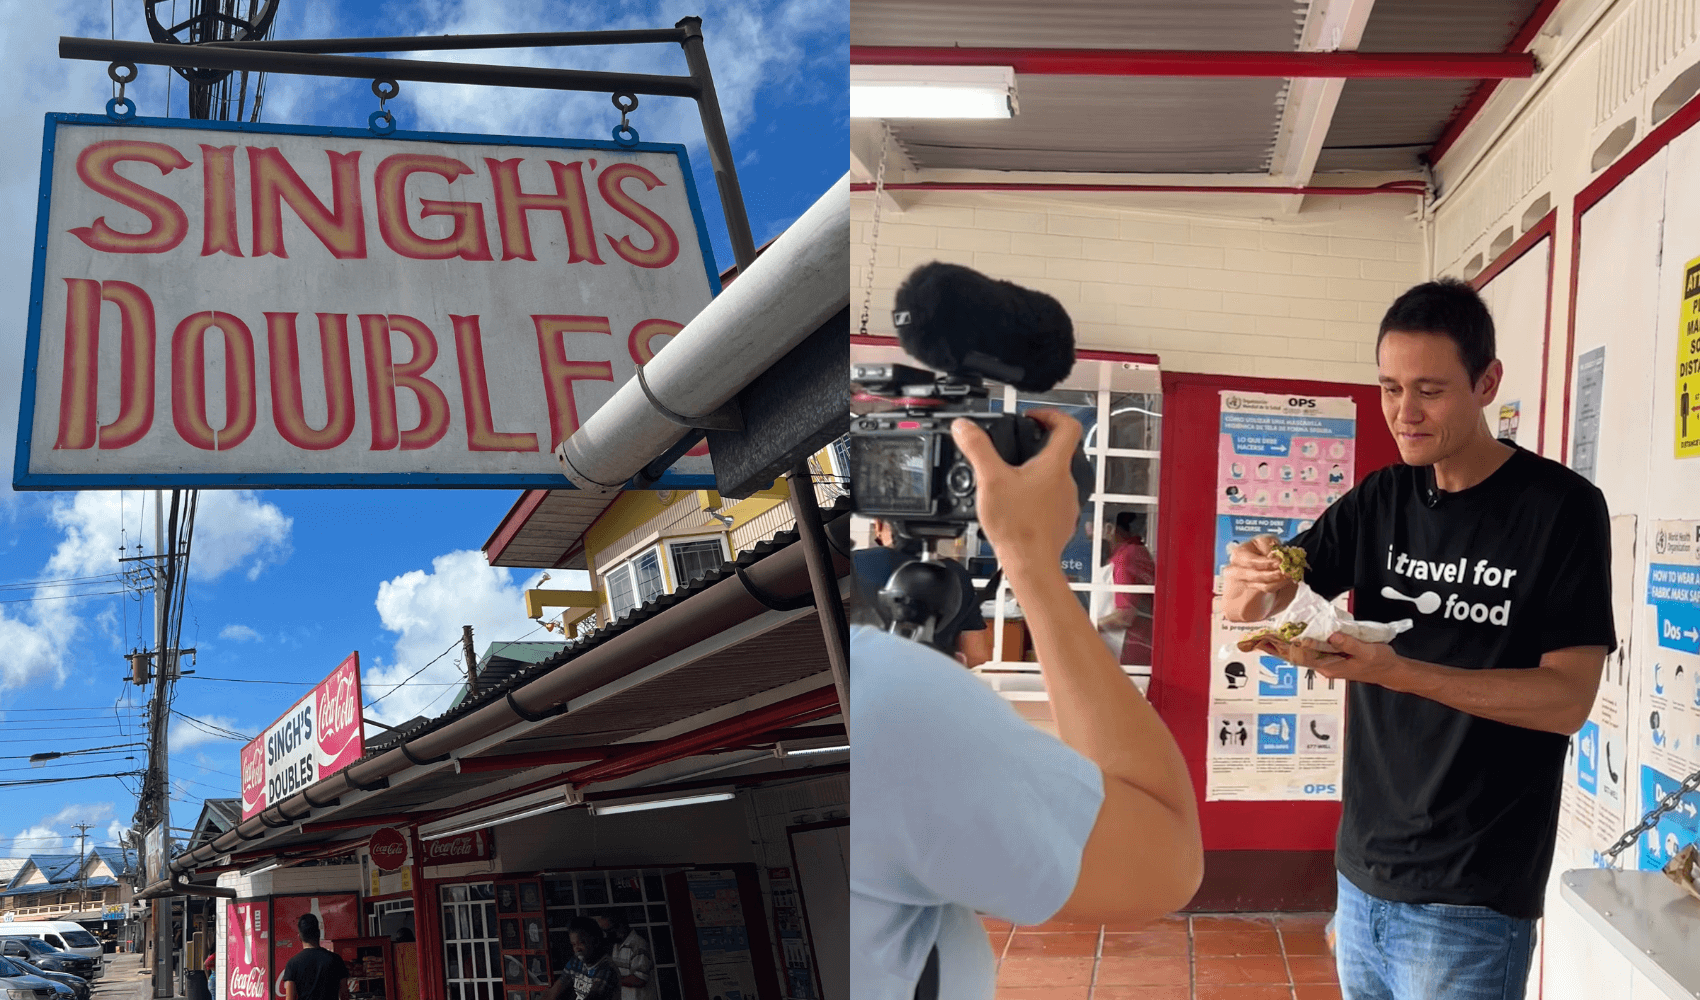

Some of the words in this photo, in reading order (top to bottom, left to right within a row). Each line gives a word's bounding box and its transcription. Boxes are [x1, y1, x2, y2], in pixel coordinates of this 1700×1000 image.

[67, 140, 680, 269] SINGH'S
[1288, 397, 1316, 408] OPS
[1061, 558, 1083, 570] ste
[1386, 543, 1394, 571] i
[1394, 552, 1468, 584] travel
[1472, 559, 1518, 589] for
[1653, 569, 1667, 582] HOW
[1668, 570, 1676, 583] TO
[1677, 571, 1695, 585] WEAR
[1671, 587, 1689, 602] MASK
[1443, 593, 1512, 627] food
[1663, 618, 1681, 641] Dos
[268, 705, 312, 767] SINGH'S
[268, 753, 314, 804] DOUBLES
[1303, 783, 1337, 794] OPS
